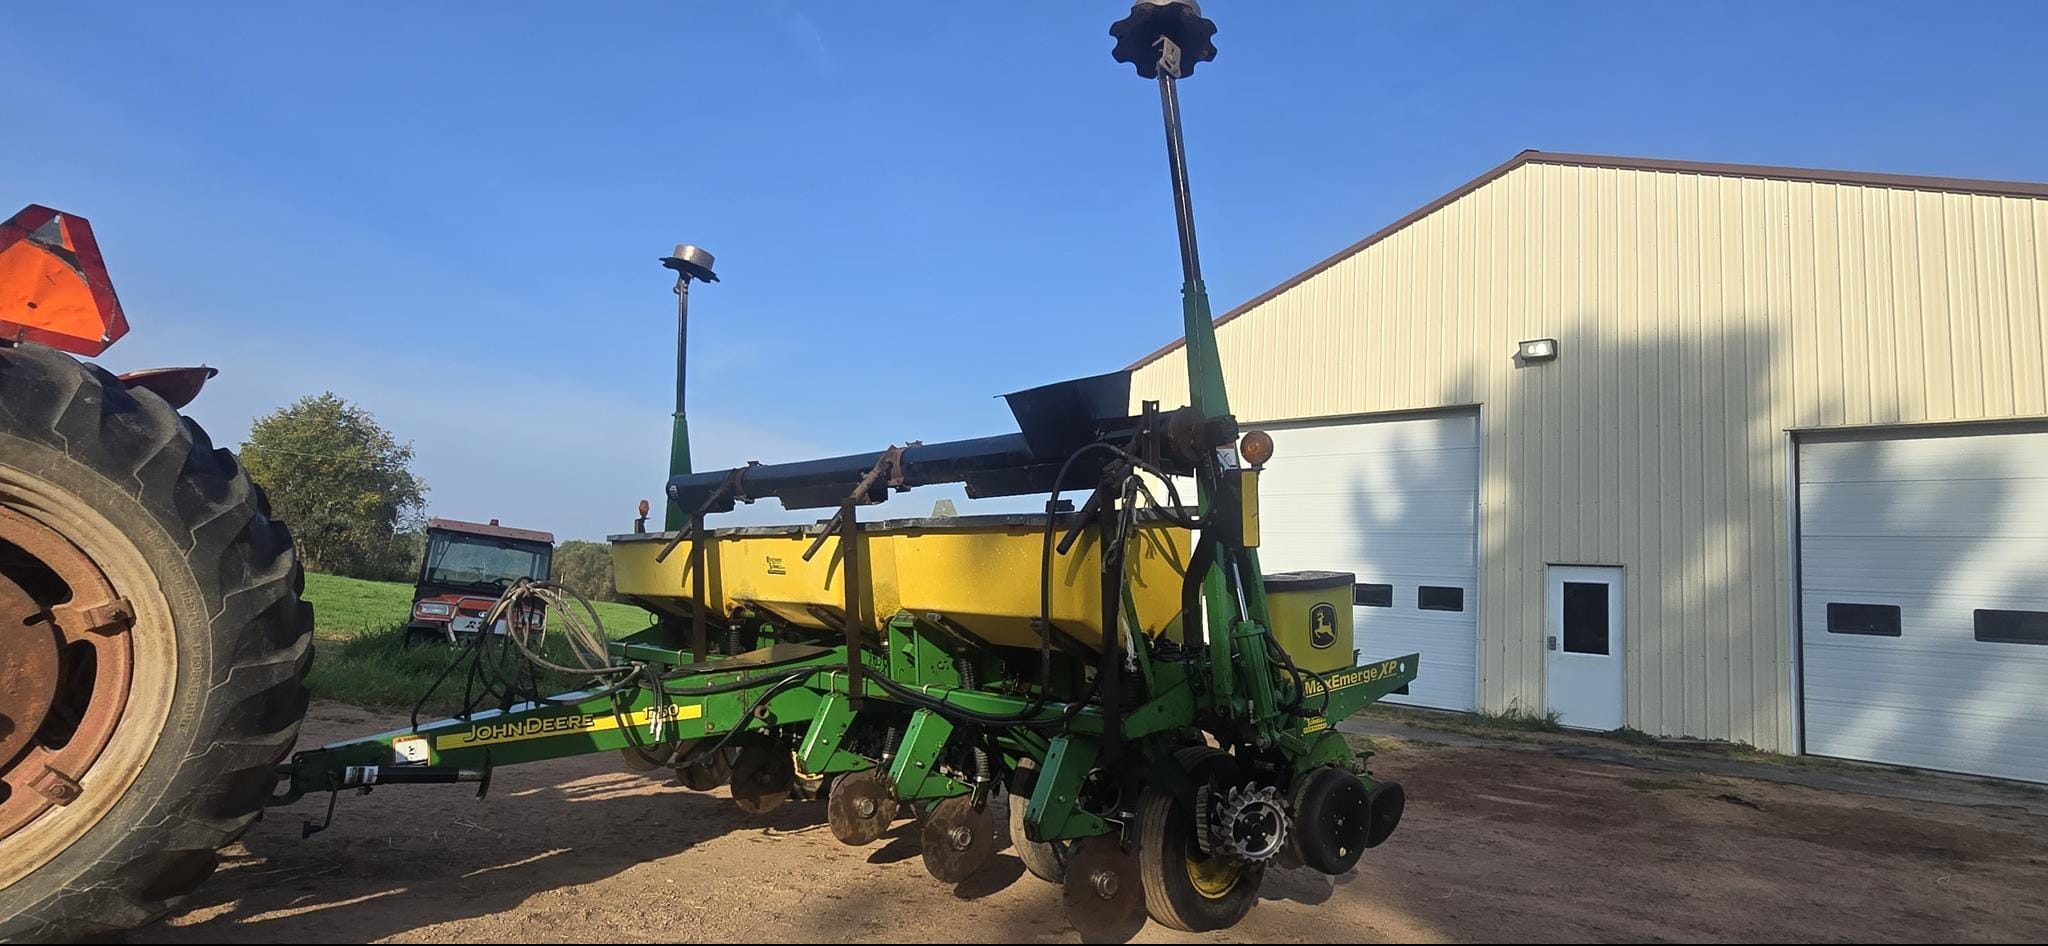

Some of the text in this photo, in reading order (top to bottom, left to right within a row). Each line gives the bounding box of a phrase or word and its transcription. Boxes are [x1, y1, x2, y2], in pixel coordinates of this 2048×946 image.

[1304, 660, 1398, 695] MaxEmerge XP
[463, 714, 594, 742] JOHN DEERE
